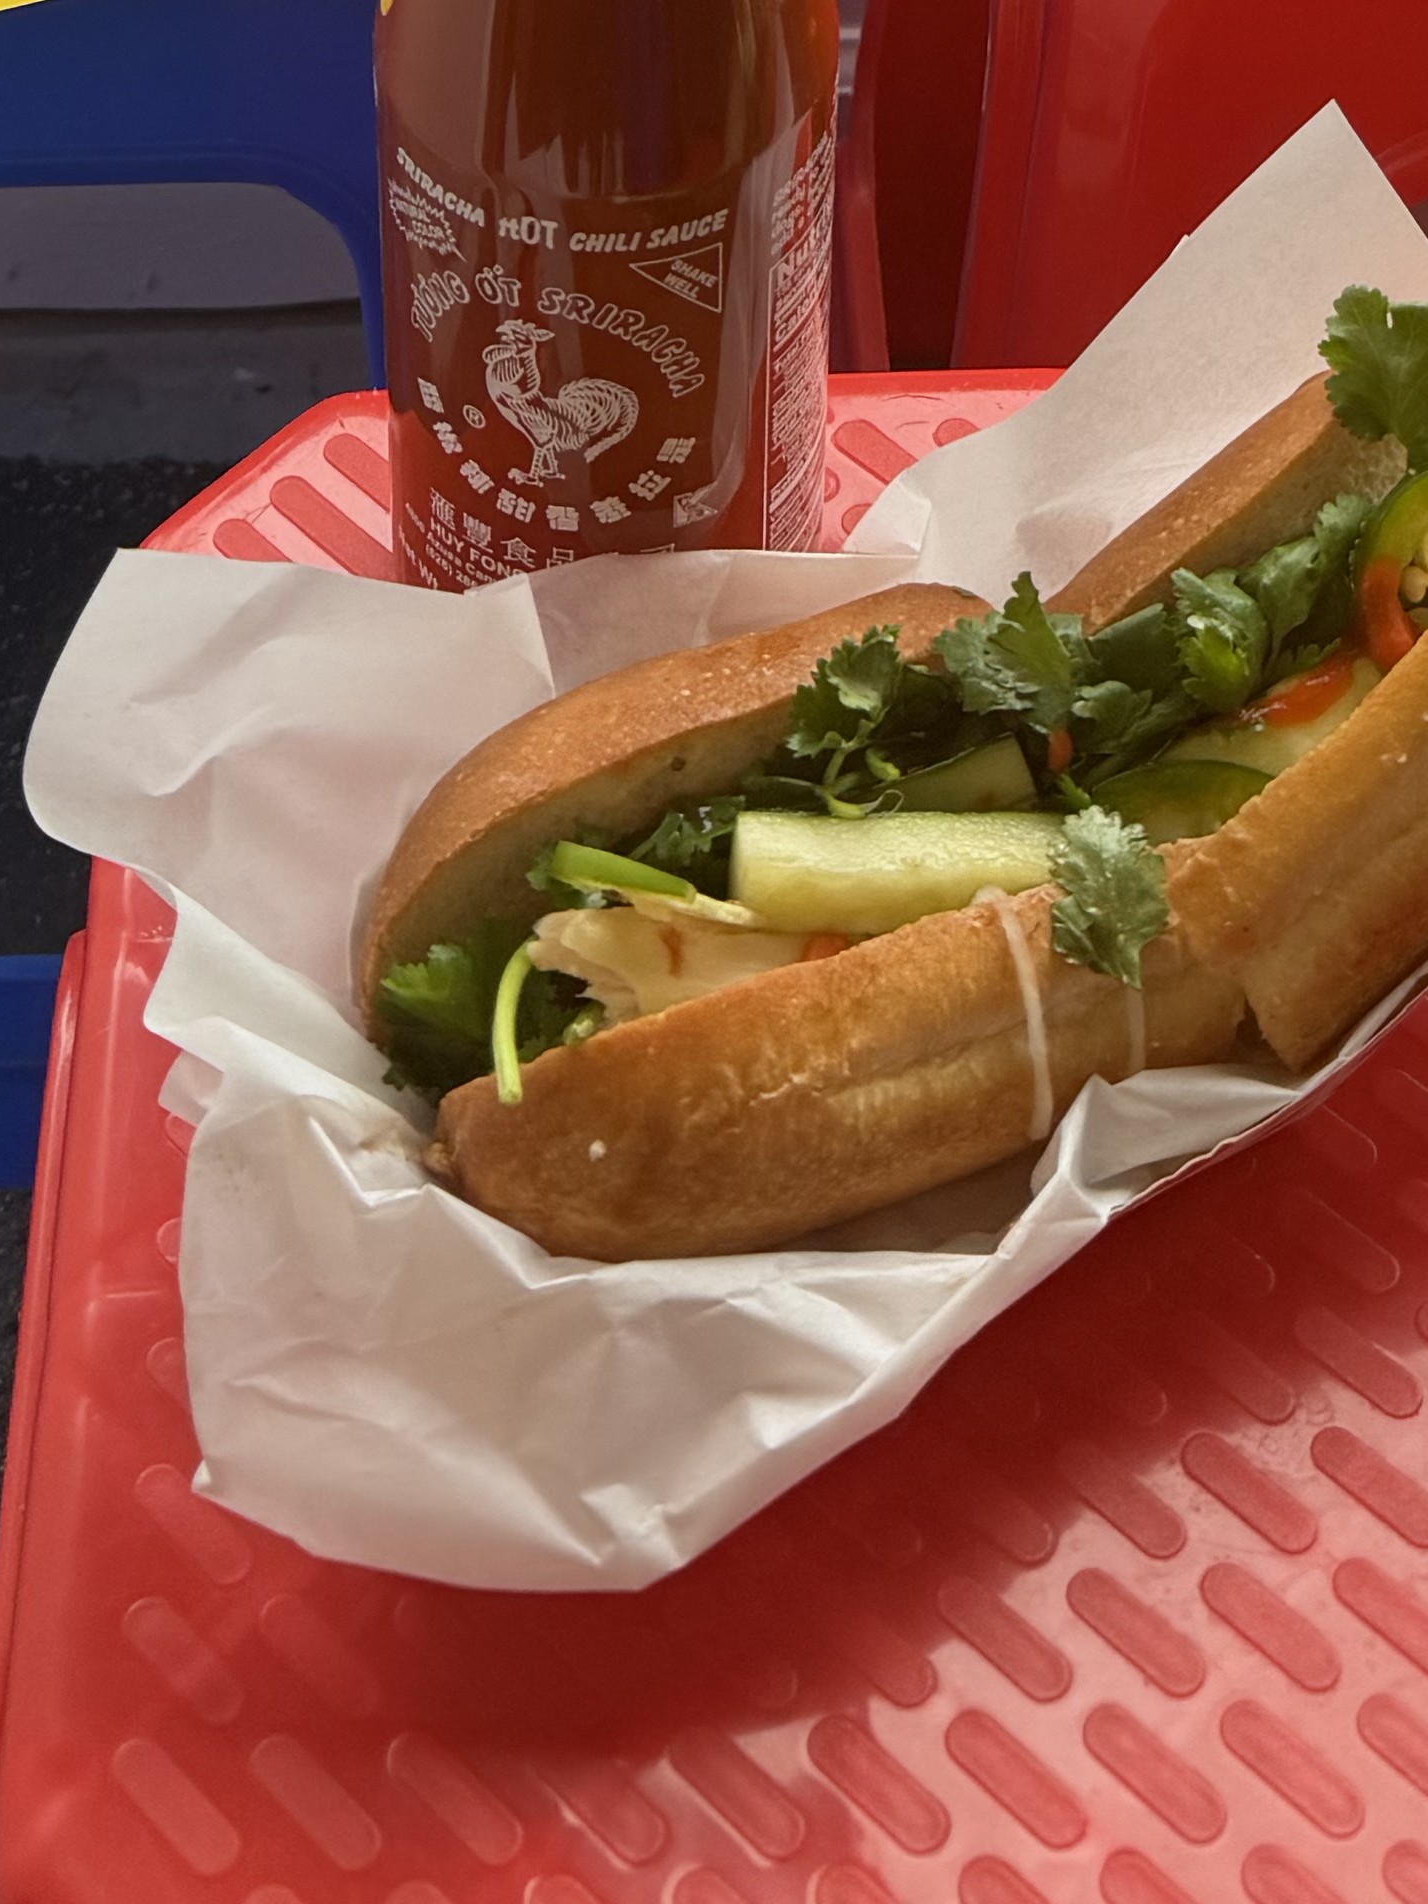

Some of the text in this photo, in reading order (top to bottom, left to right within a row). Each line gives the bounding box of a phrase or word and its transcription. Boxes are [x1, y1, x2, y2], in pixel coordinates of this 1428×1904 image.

[397, 147, 729, 253] SRIRACHA HOT CHILI SAUCE
[664, 273, 699, 298] WELL
[670, 257, 718, 288] SHAKE
[537, 286, 704, 398] SRIRACHA
[431, 517, 465, 552] HUY
